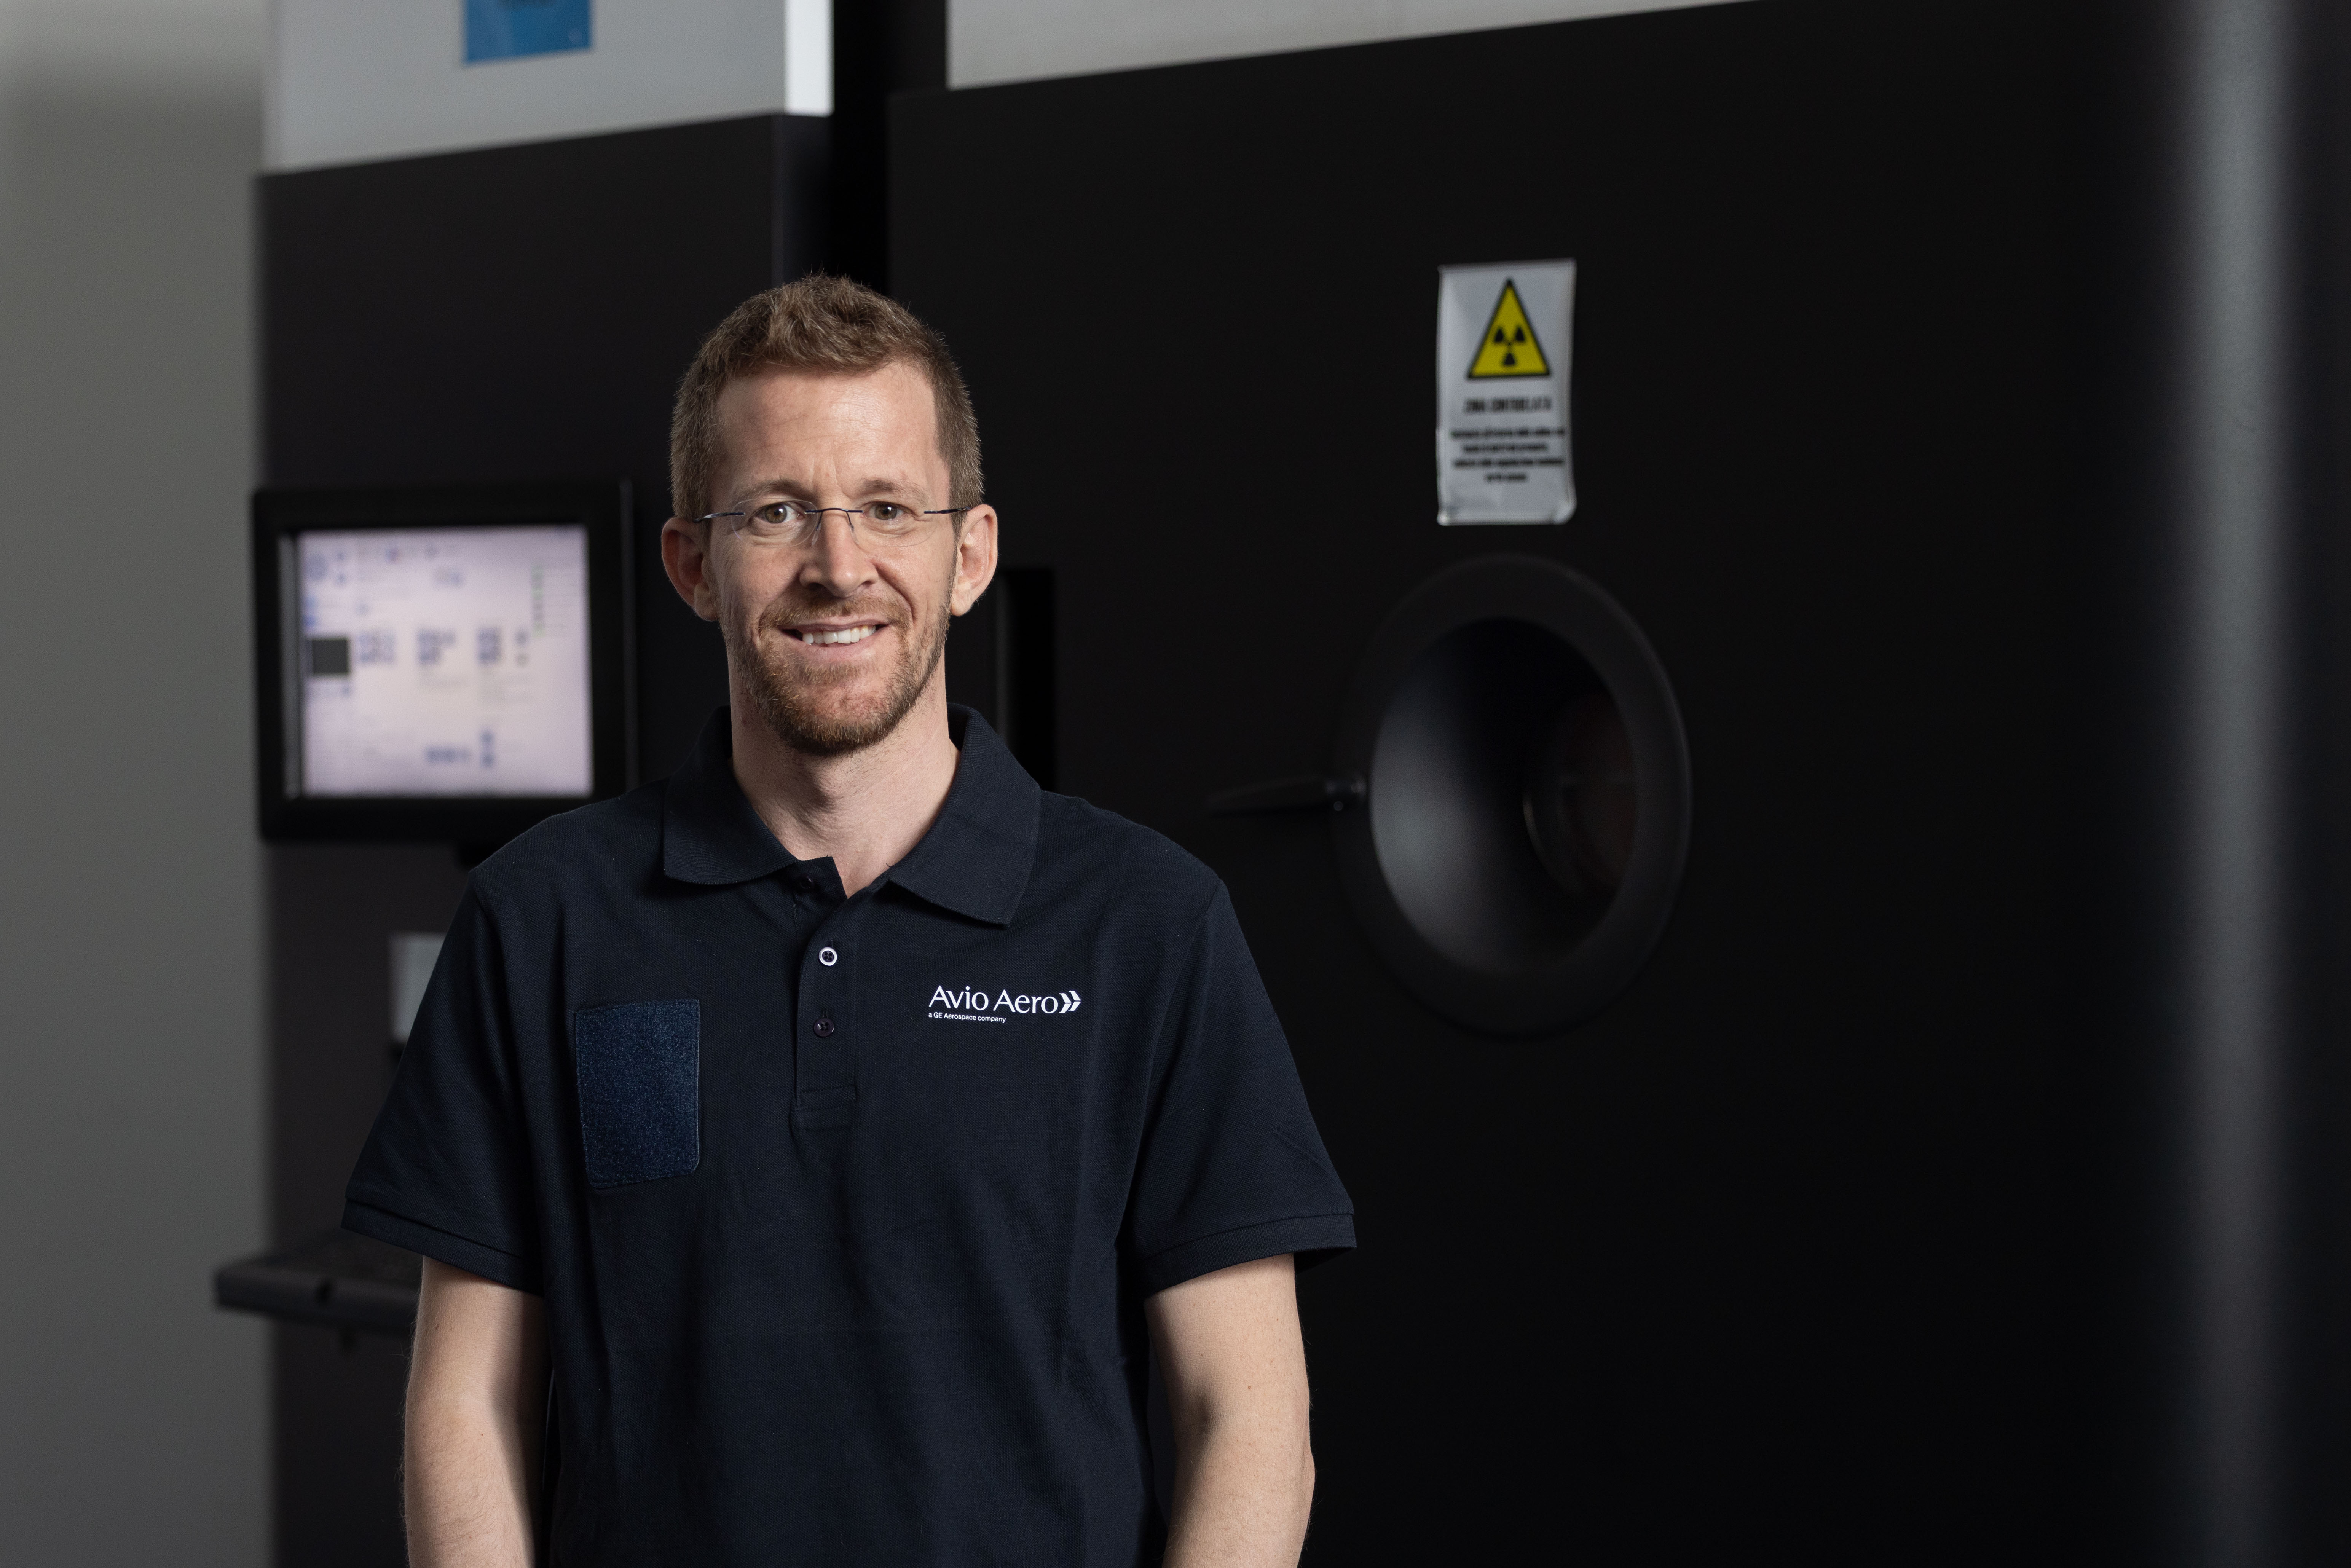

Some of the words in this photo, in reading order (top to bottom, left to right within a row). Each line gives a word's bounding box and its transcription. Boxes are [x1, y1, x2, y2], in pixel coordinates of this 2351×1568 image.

[929, 985, 989, 1011] Avio
[993, 989, 1059, 1014] Aero
[944, 1013, 976, 1021] Aerospace
